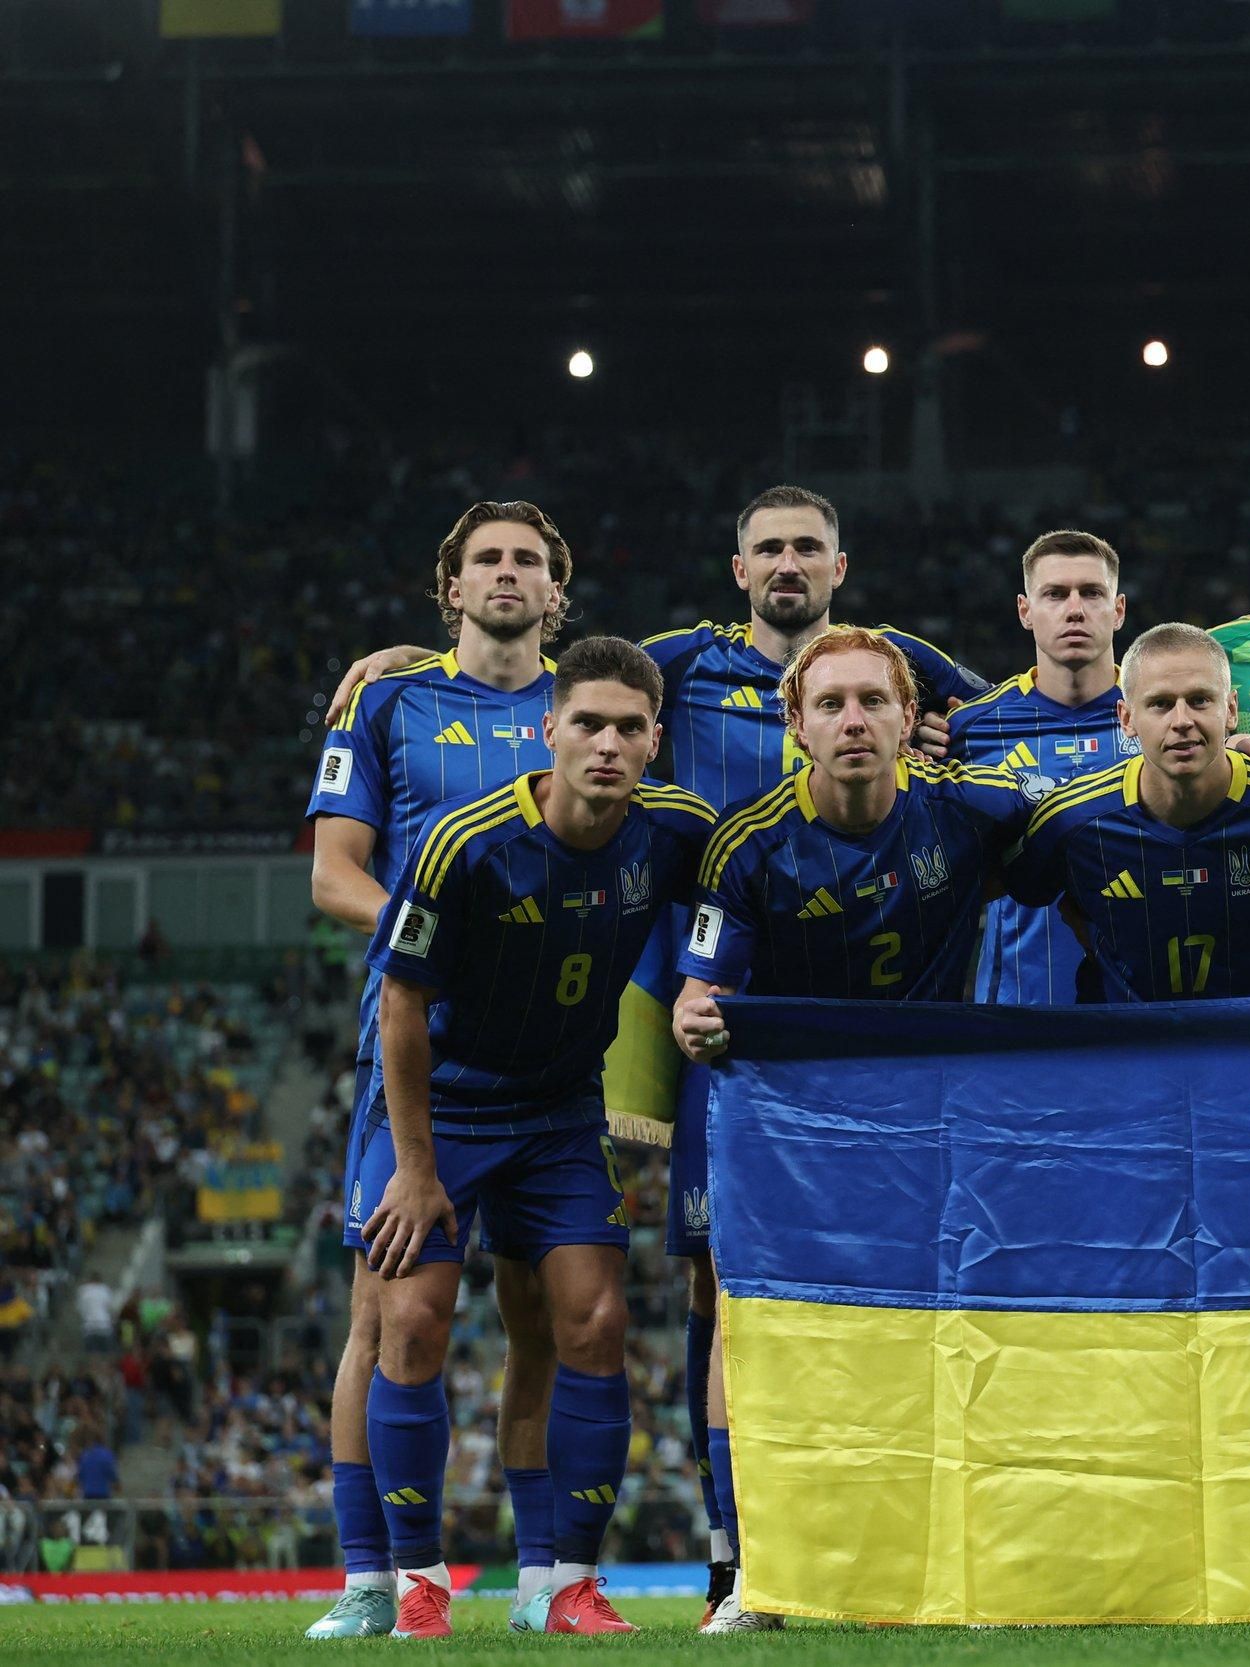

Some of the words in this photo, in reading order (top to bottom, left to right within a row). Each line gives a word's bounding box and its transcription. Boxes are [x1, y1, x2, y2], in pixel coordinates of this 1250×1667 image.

[622, 903, 649, 916] UKRAINE
[555, 953, 593, 1007] 8
[868, 931, 902, 986] 2
[1167, 934, 1216, 993] 17
